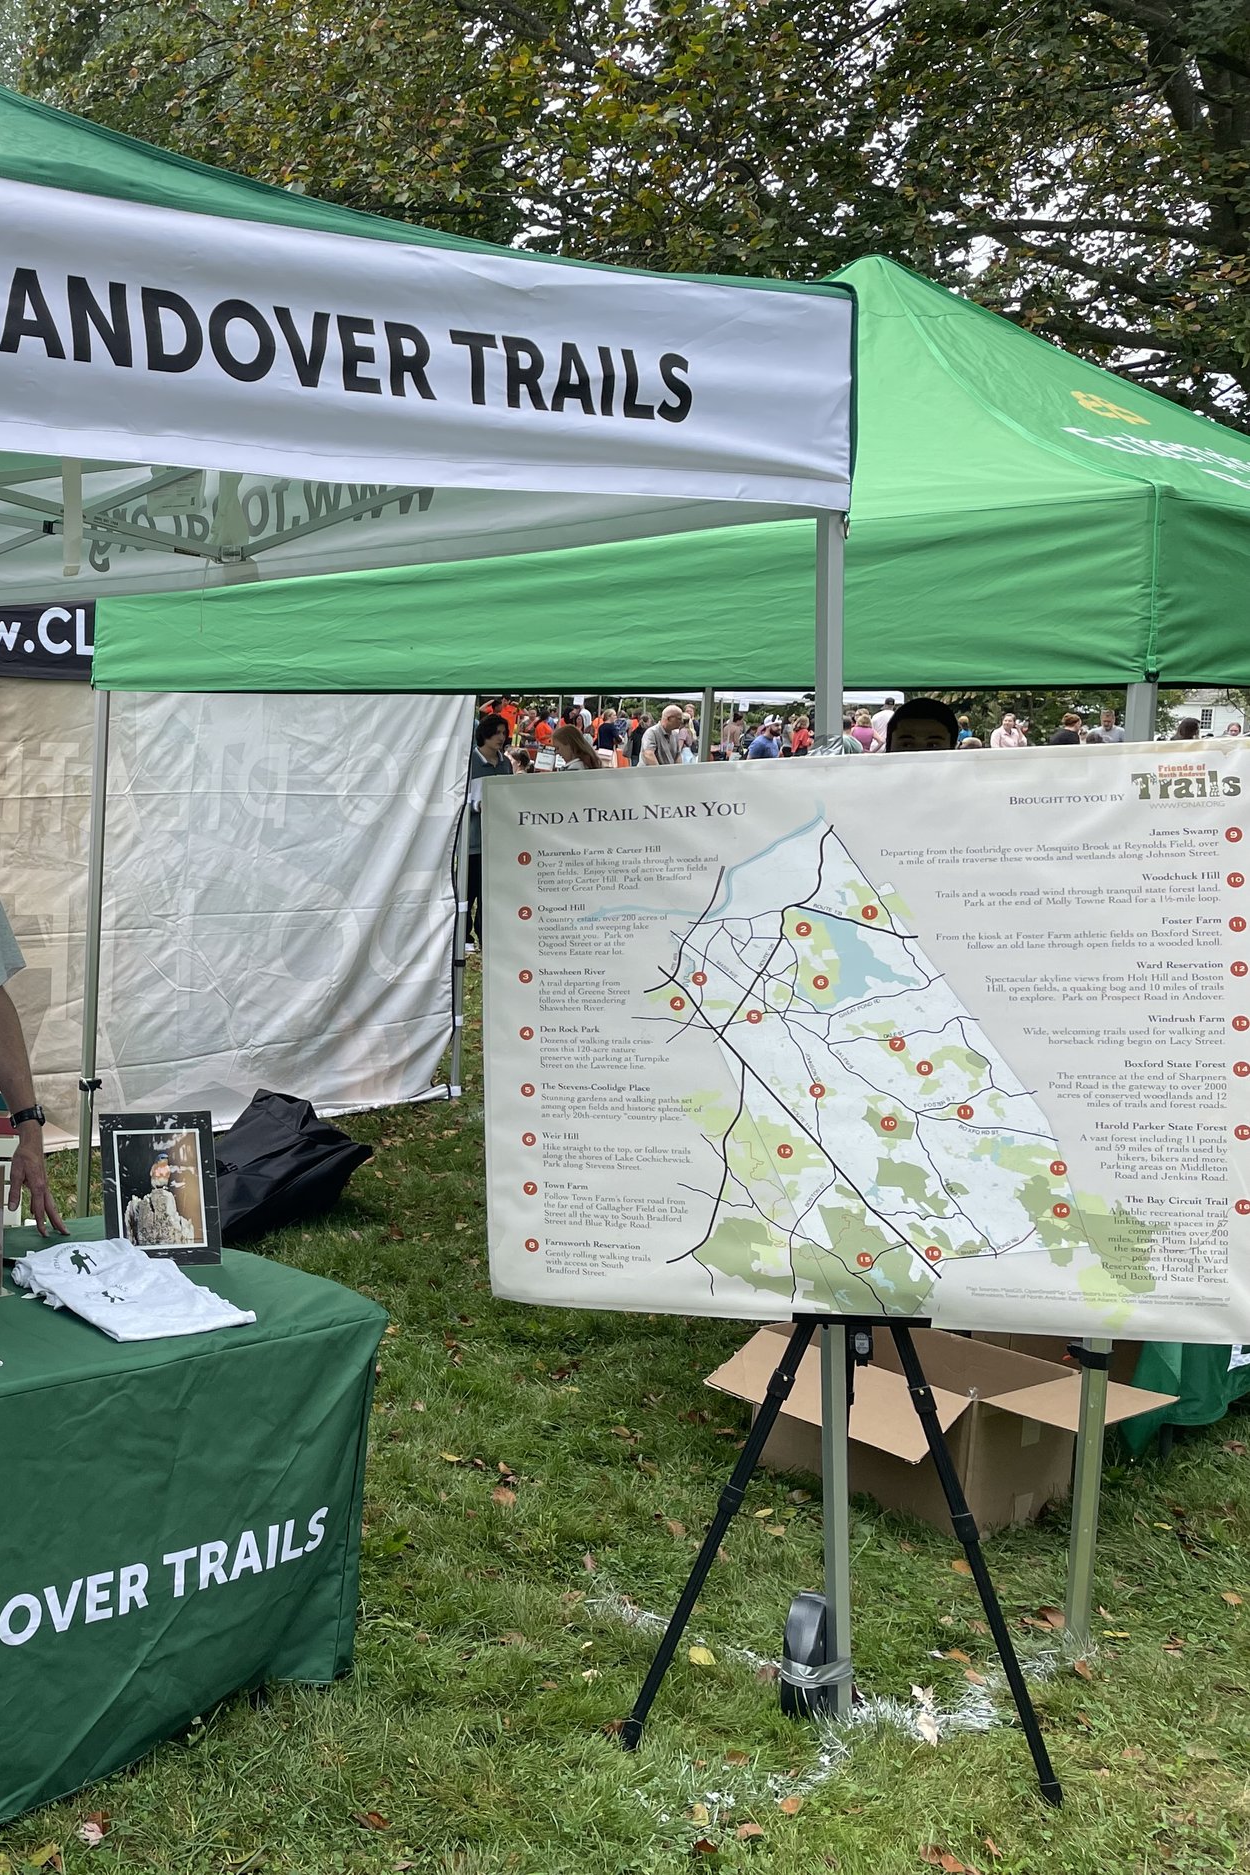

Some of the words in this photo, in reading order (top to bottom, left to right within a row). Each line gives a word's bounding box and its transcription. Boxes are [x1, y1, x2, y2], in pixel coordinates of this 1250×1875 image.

[450, 328, 694, 424] TRAILS
[1158, 764, 1193, 772] Friends
[1196, 763, 1206, 771] of
[1130, 770, 1241, 800] Trails
[1009, 795, 1064, 806] BROUGHT
[517, 810, 564, 826] FIND
[567, 812, 580, 825] A
[583, 806, 639, 823] TRAIL
[642, 803, 698, 820] NEAR
[700, 800, 747, 817] YOU
[1149, 828, 1180, 837] James
[1182, 827, 1219, 837] Swamp
[537, 849, 581, 857] Mazurenko
[583, 848, 605, 856] Farm
[616, 846, 642, 854] Carter
[645, 845, 661, 853] Hill
[537, 860, 556, 868] Over
[565, 860, 584, 868] miles
[595, 858, 620, 868] hiking
[621, 858, 642, 866] trails
[643, 857, 674, 866] through
[676, 855, 702, 863] woods
[703, 855, 719, 863] and
[1142, 872, 1198, 881] Woodchuck
[1201, 871, 1221, 880] Hill
[537, 905, 568, 914] Osgood
[570, 904, 586, 912] Hill
[1161, 917, 1193, 925] Foster
[1196, 916, 1222, 925] Farm
[1136, 961, 1163, 969] Ward
[1166, 960, 1224, 969] Reservation
[538, 968, 582, 976] Shawsheen
[584, 968, 605, 976] River
[1148, 1014, 1196, 1023] Windrush
[1199, 1015, 1225, 1023] Farm
[540, 1037, 568, 1045] Dozens
[579, 1037, 609, 1046] walking
[611, 1037, 631, 1045] trails
[1124, 1059, 1164, 1068] Boxford
[1166, 1060, 1192, 1068] State
[1195, 1060, 1226, 1068] Forest
[1057, 1072, 1075, 1080] The
[1077, 1073, 1116, 1081] entrance
[1130, 1072, 1145, 1081] the
[1147, 1072, 1164, 1081] end
[1179, 1073, 1227, 1083] Sharpners
[541, 1083, 556, 1091] The
[558, 1083, 626, 1092] Stevens-Coolidge
[629, 1084, 650, 1092] Place
[1095, 1122, 1129, 1130] Harold
[1132, 1122, 1165, 1131] Parker
[1168, 1123, 1193, 1131] State
[1196, 1123, 1227, 1132] Forest
[542, 1132, 561, 1140] Weir
[563, 1132, 579, 1140] Hill
[1095, 1143, 1112, 1151] and
[1128, 1144, 1152, 1152] miles
[1166, 1145, 1190, 1153] trails
[1192, 1145, 1214, 1154] used
[1216, 1145, 1228, 1155] by
[543, 1181, 564, 1189] Town
[567, 1182, 589, 1190] Farm
[1125, 1195, 1144, 1204] The
[1147, 1196, 1165, 1206] Bay
[1168, 1196, 1202, 1205] Circuit
[1205, 1197, 1228, 1206] Trail
[545, 1239, 591, 1248] Farnsworth
[593, 1240, 641, 1250] Reservation
[162, 1506, 329, 1599] TRAILS
